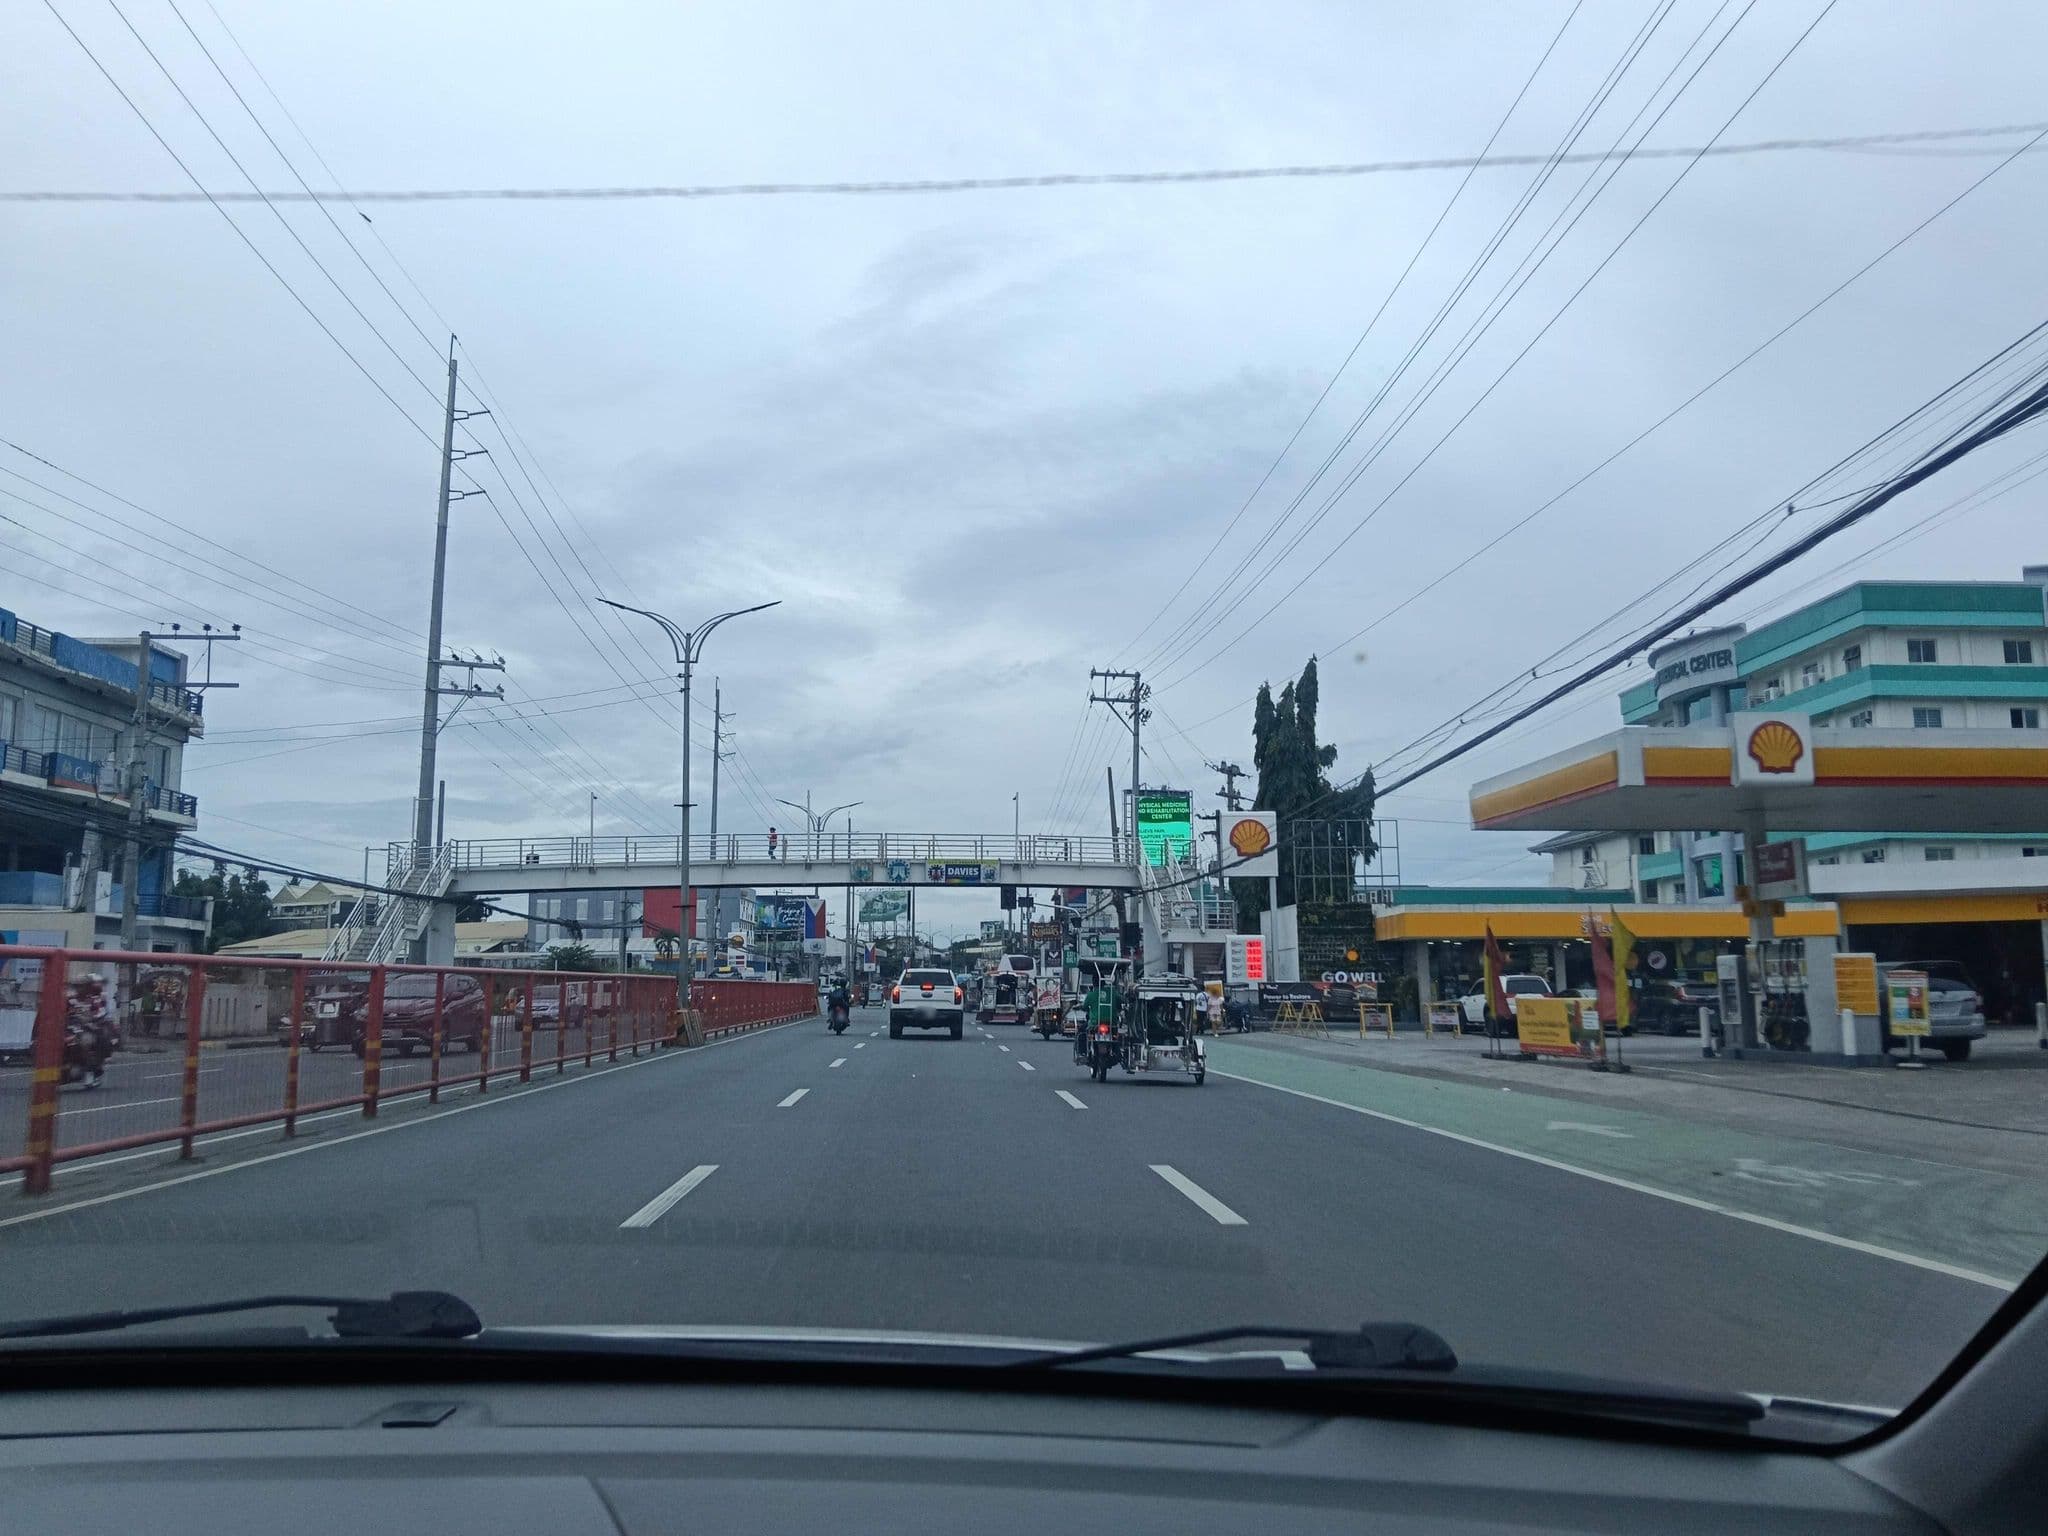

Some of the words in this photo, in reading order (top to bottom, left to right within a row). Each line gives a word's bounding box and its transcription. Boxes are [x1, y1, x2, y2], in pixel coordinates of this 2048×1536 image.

[1690, 649, 1733, 673] CENTER
[947, 867, 979, 875] DAVIES
[1321, 971, 1348, 983] GO
[1350, 971, 1385, 983] WELL
